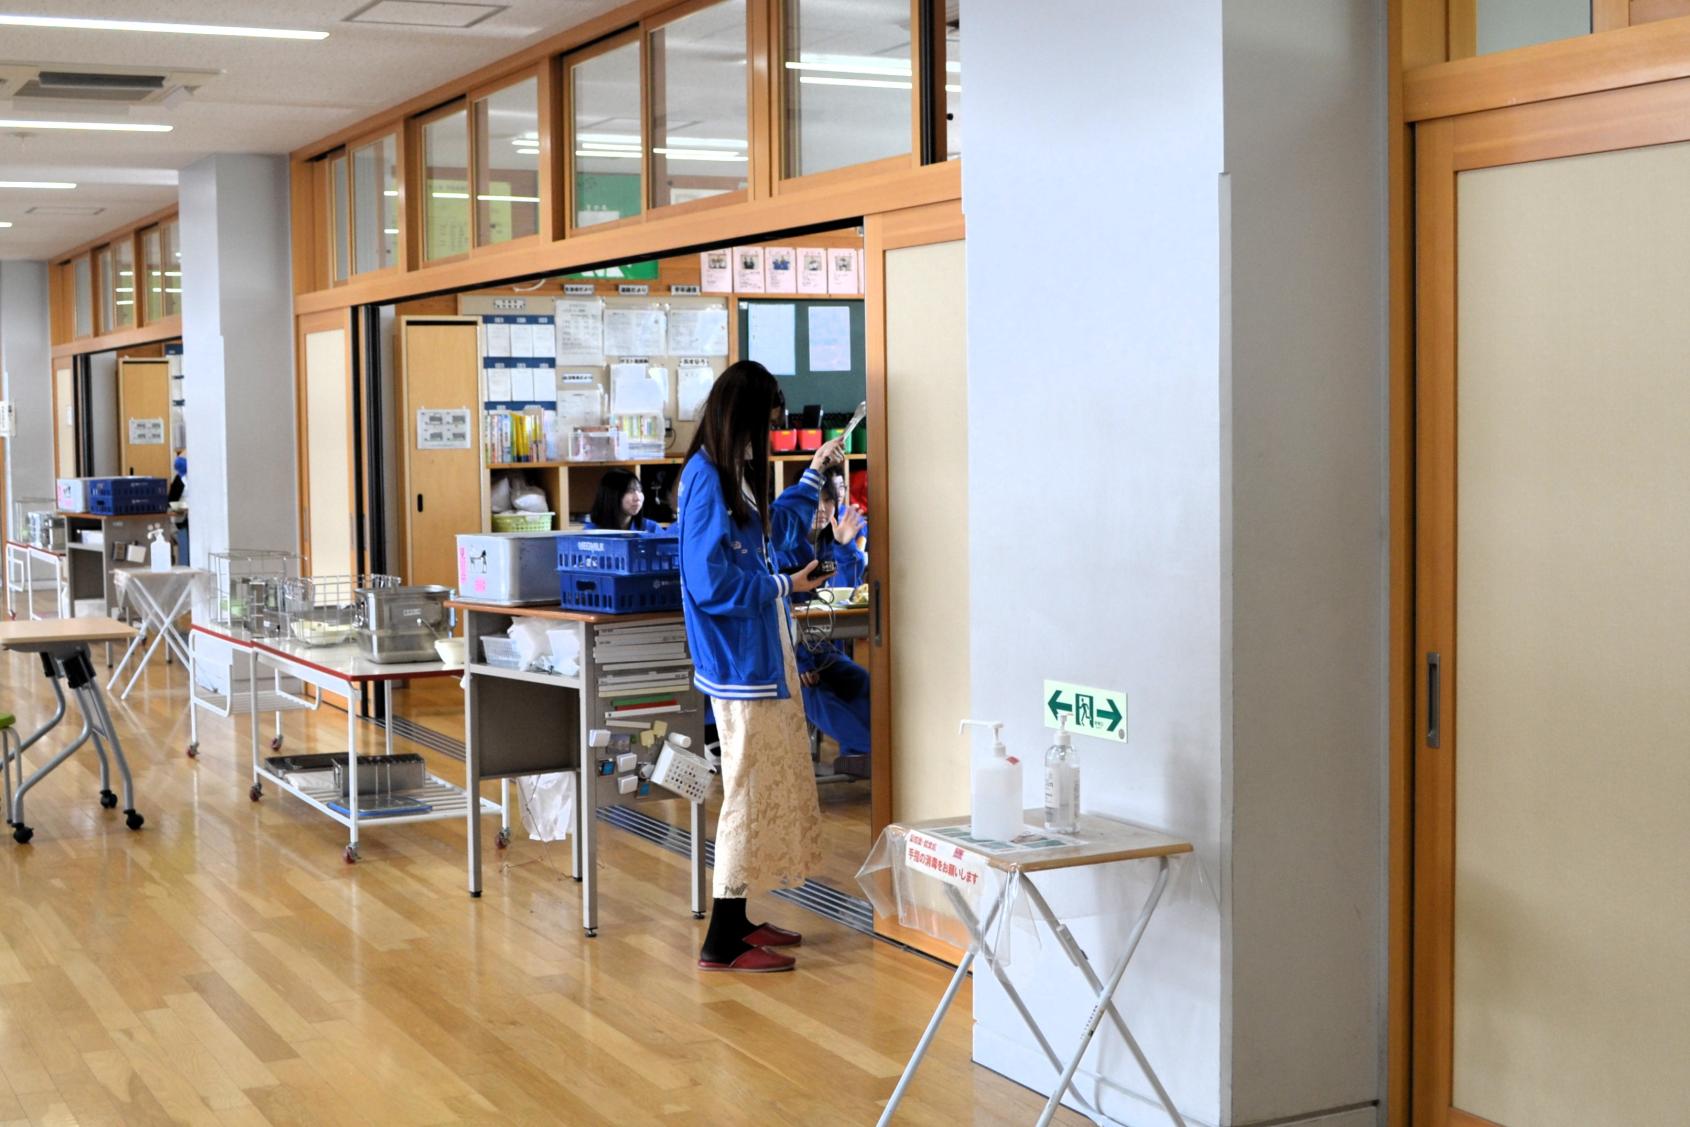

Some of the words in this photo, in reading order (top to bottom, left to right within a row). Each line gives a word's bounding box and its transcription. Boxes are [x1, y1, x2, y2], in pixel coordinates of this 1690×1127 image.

[908, 847, 979, 885] 手指の消毒をお願いします
